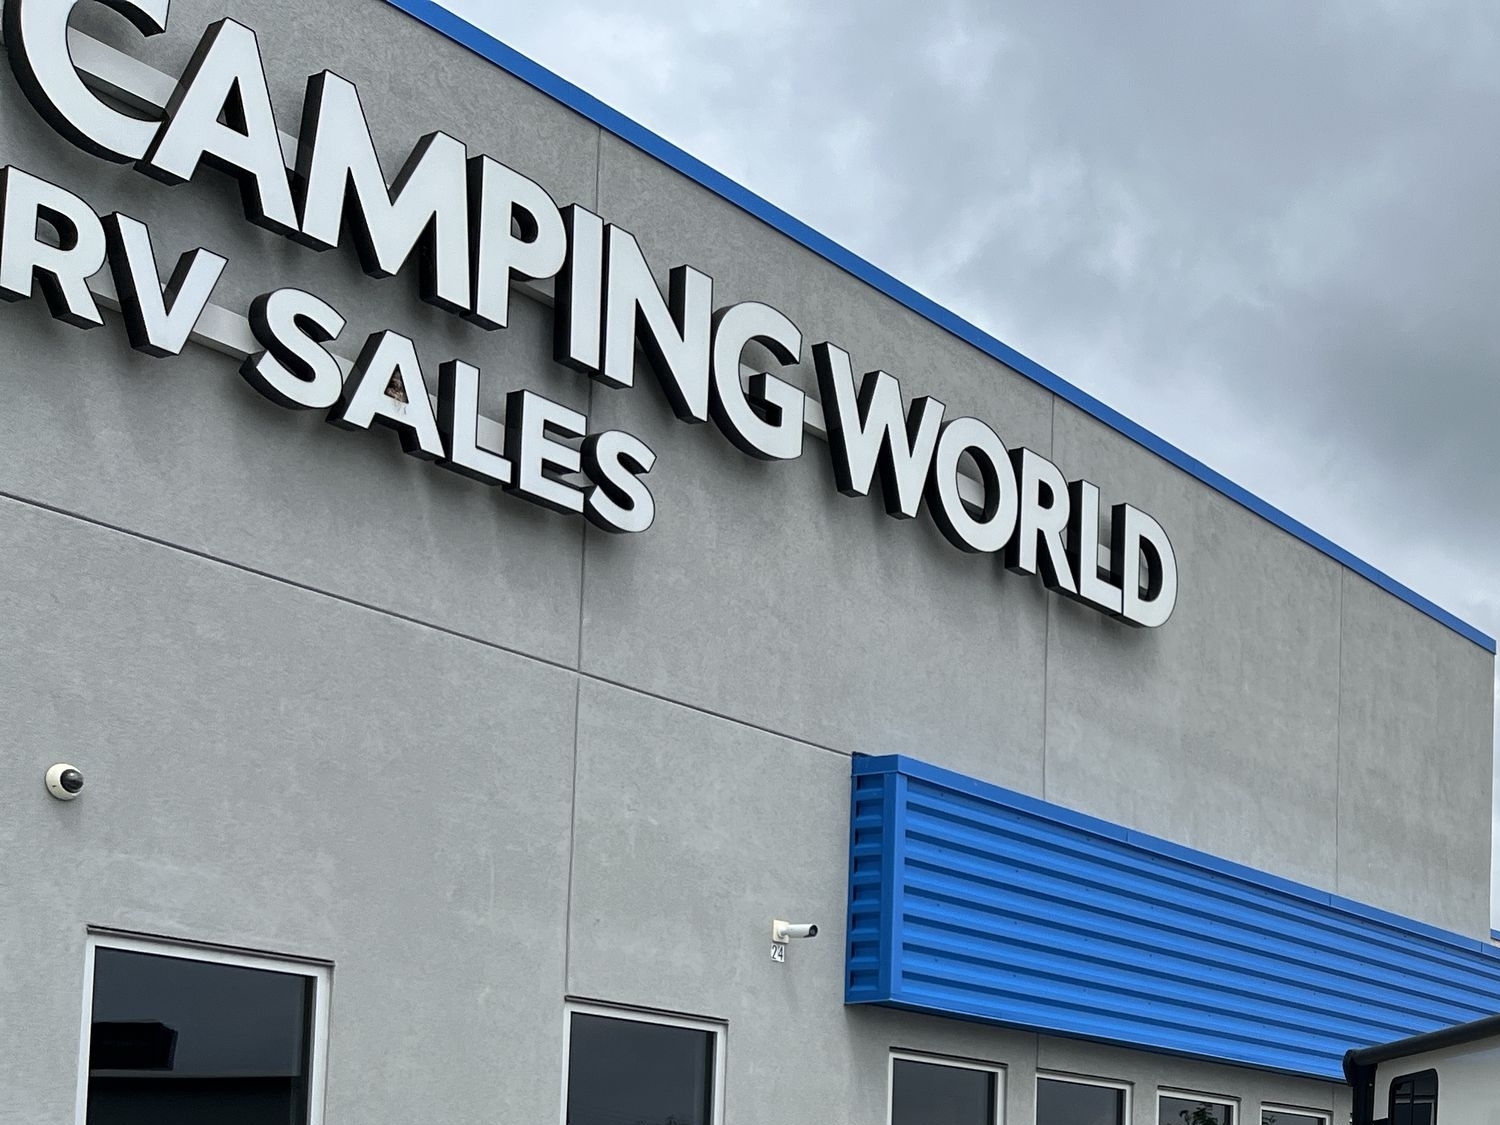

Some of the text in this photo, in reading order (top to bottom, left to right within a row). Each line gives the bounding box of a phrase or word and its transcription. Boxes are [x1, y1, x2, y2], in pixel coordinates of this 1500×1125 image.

[0, 165, 657, 533] RV SALES
[4, 0, 1178, 628] CAMPING WORLD
[771, 944, 784, 961] 24
